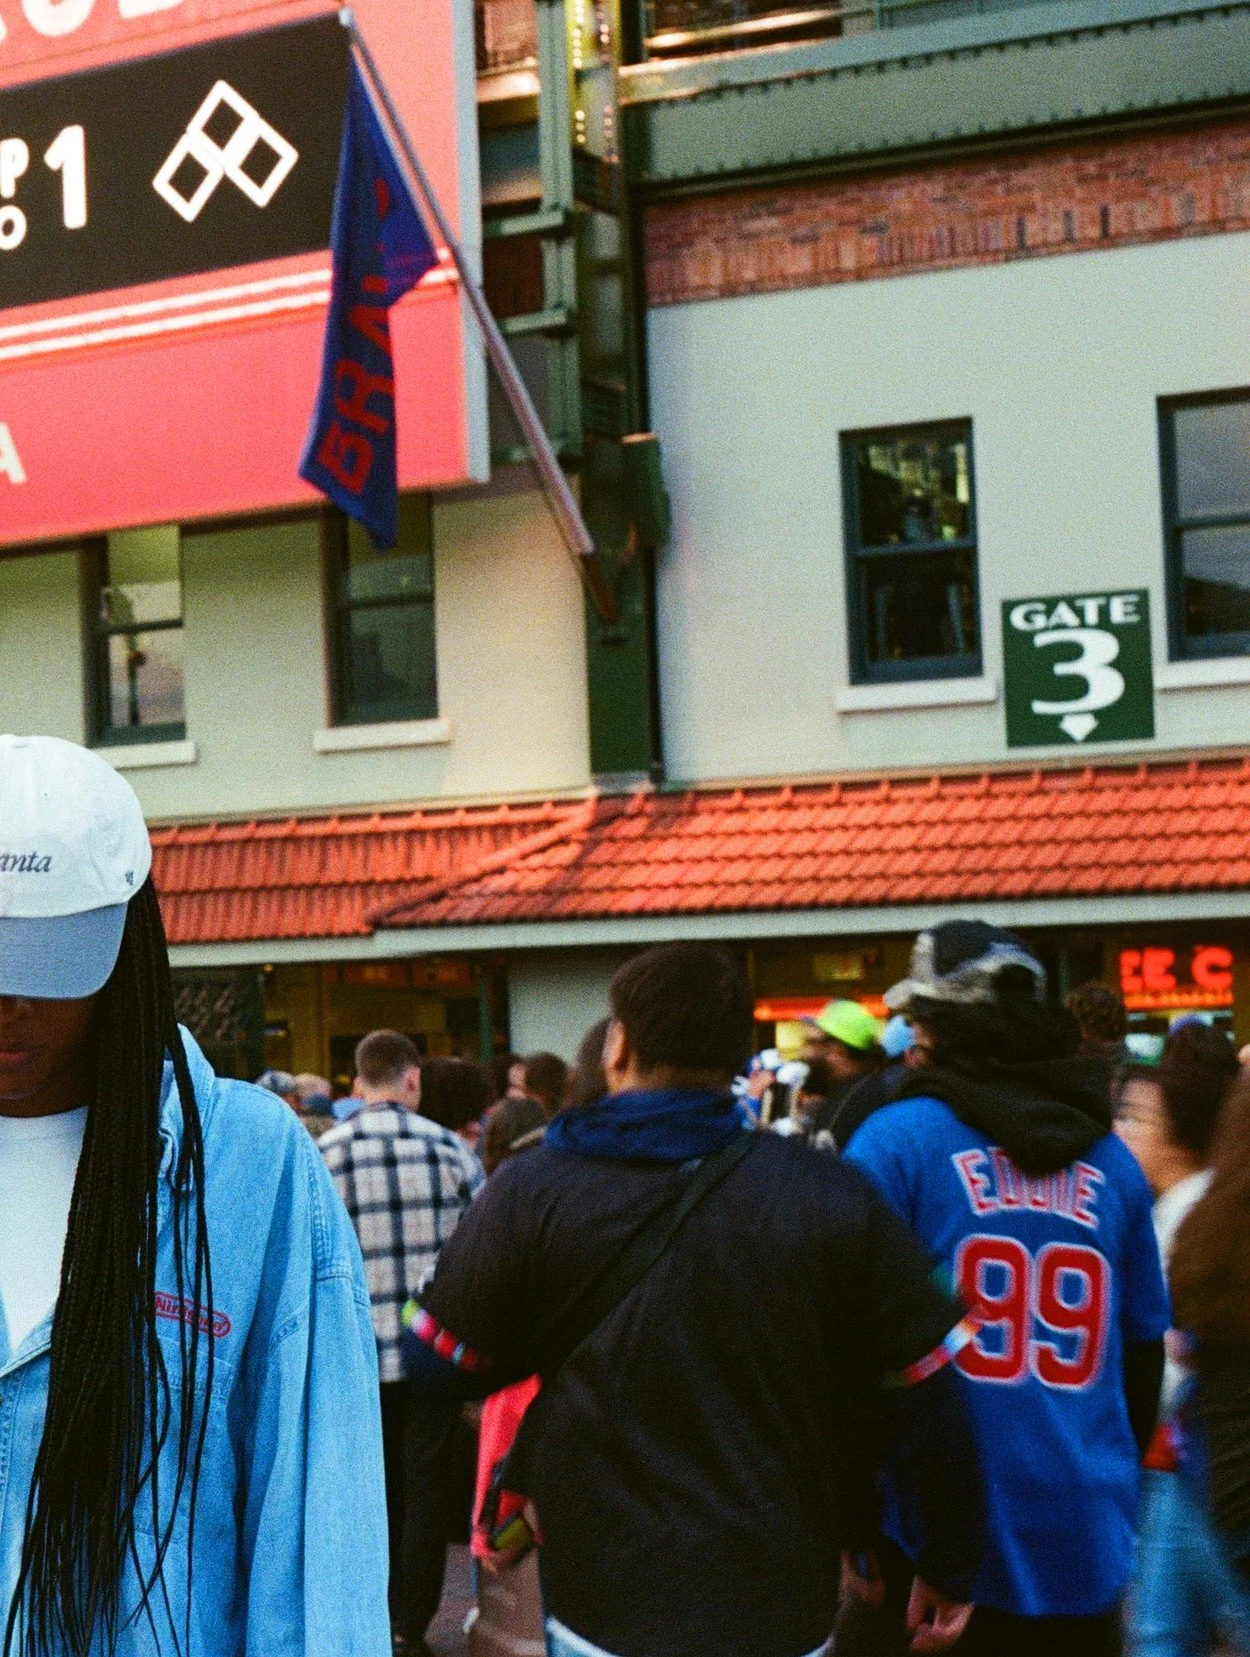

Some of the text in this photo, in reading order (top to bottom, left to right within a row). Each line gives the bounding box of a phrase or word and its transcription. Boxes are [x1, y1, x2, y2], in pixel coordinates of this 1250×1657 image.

[43, 124, 87, 229] 1
[317, 172, 395, 496] BRA
[1009, 593, 1142, 631] GATE
[1030, 627, 1125, 716] 3
[952, 1232, 1112, 1392] 99
